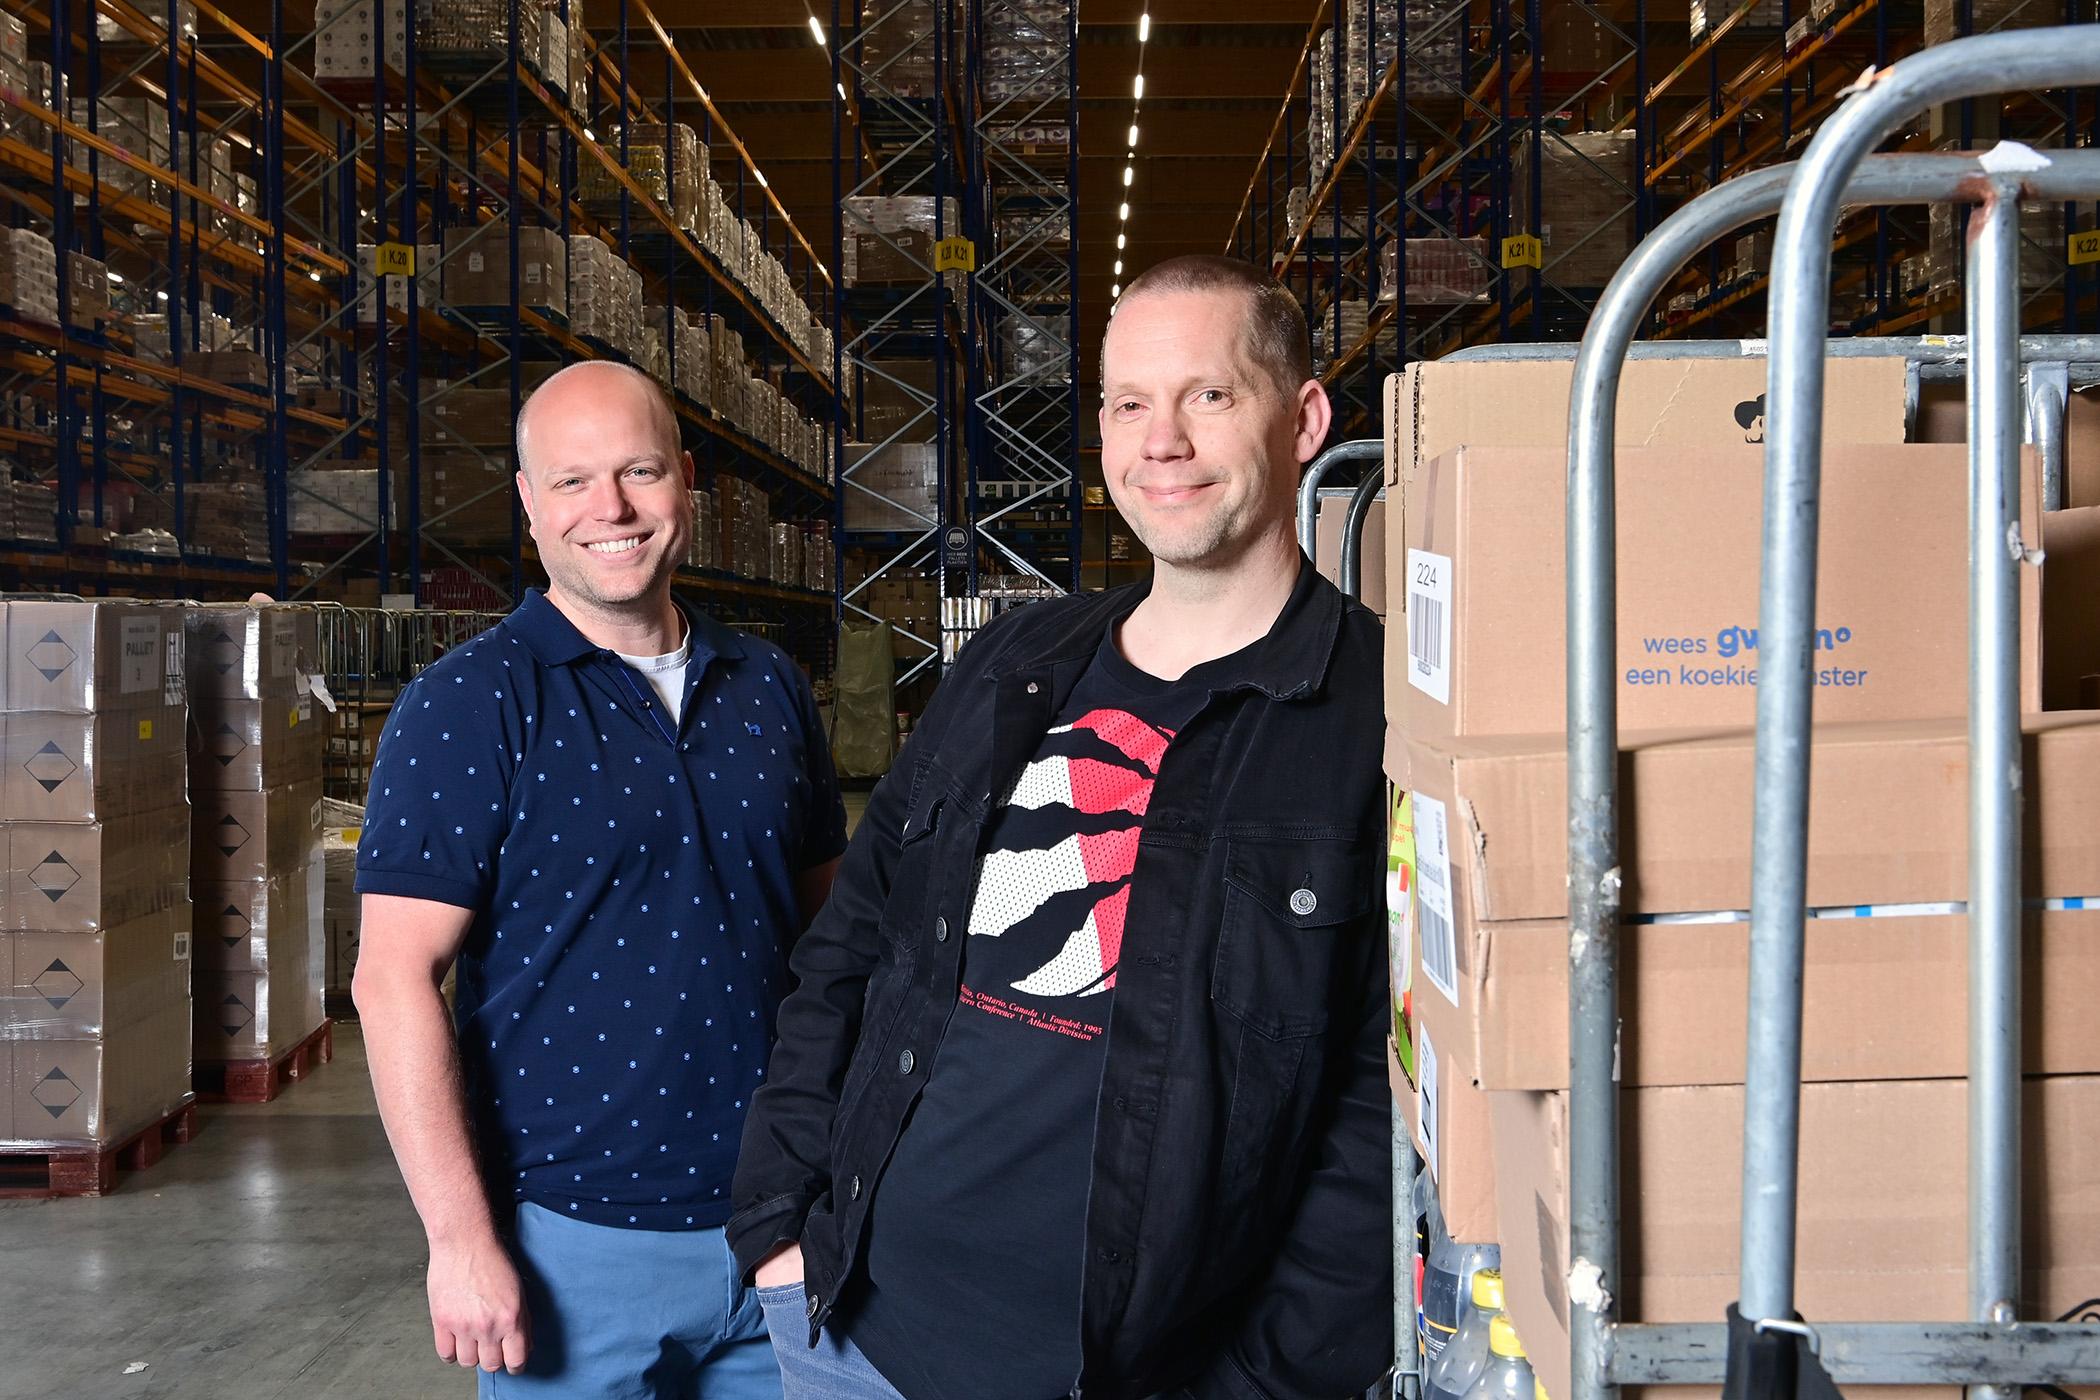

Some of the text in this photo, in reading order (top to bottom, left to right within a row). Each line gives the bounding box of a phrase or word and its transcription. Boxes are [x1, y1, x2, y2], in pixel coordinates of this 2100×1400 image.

[1417, 562, 1437, 588] 224
[126, 641, 154, 656] PALLET
[1643, 637, 1707, 654] wees
[1626, 664, 1868, 686] een koekiester
[976, 992, 1007, 1009] Ontario,
[1009, 1002, 1038, 1018] Canada
[1050, 1015, 1082, 1030] Founded:
[1084, 1024, 1103, 1035] 1995
[977, 1001, 1016, 1019] Conference
[1027, 1017, 1057, 1032] Atlantic
[1057, 1025, 1092, 1040] Division
